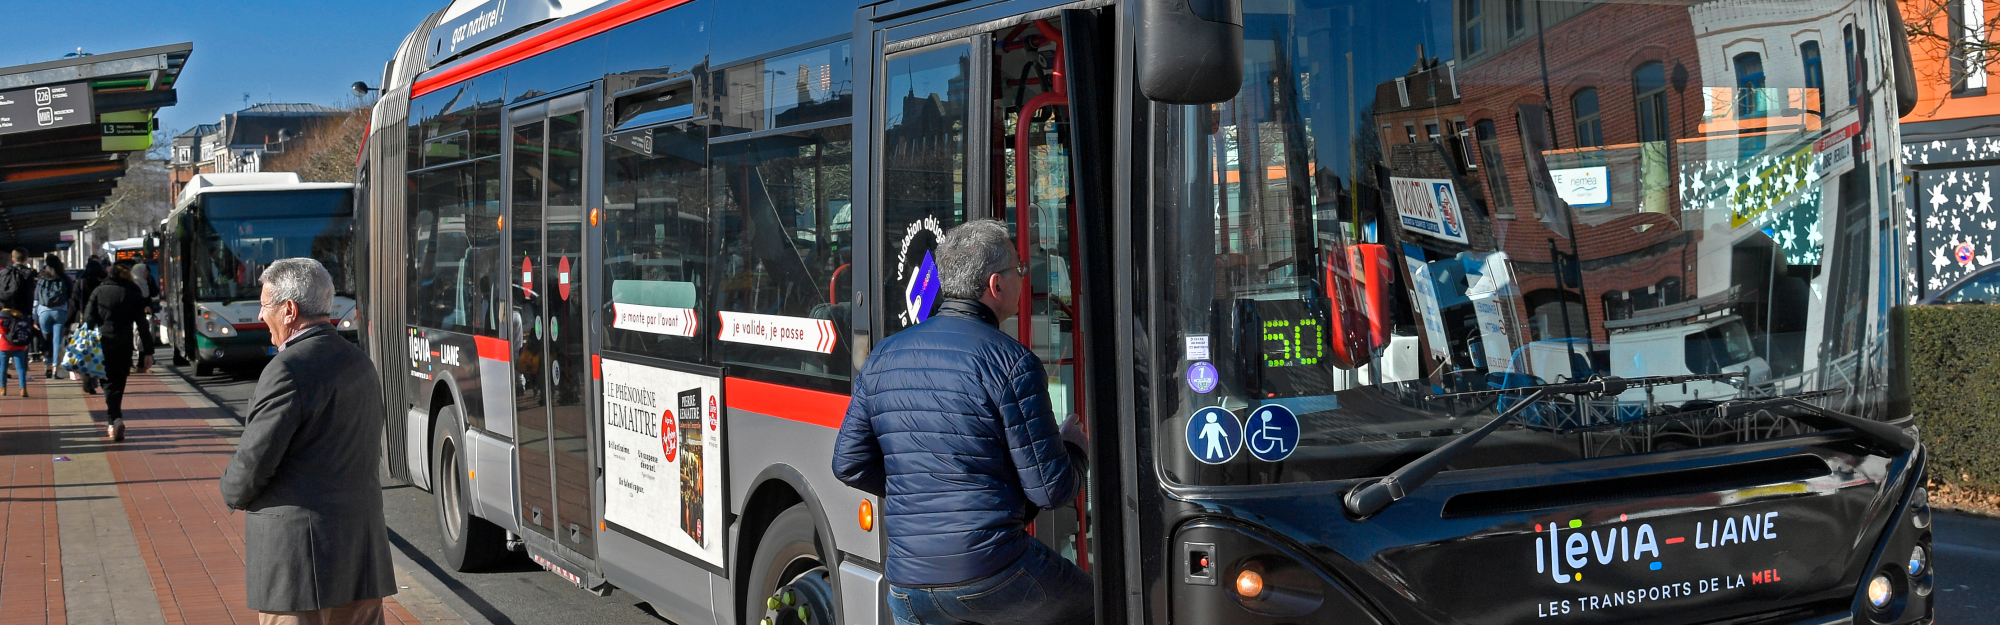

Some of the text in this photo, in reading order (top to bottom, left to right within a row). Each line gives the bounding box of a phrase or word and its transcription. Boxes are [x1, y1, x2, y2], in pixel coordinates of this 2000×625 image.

[451, 24, 467, 52] gaz
[467, 9, 500, 36] naturel
[37, 92, 48, 102] 226
[104, 125, 114, 133] L3
[897, 219, 921, 280] validation
[621, 310, 678, 327] je monte par l'avant
[733, 319, 804, 342] je valide, je passe
[1264, 318, 1322, 366] 50
[441, 344, 460, 367] LIANE
[607, 382, 656, 408] LE PHÉNOMÈNE
[682, 395, 696, 407] PIERRE
[607, 402, 658, 438] LEMAITRE
[680, 407, 700, 420] LEMAITRE
[1695, 512, 1778, 549] LIANE
[1538, 569, 1781, 618] LES TRANSPORTS DE LA MEL
